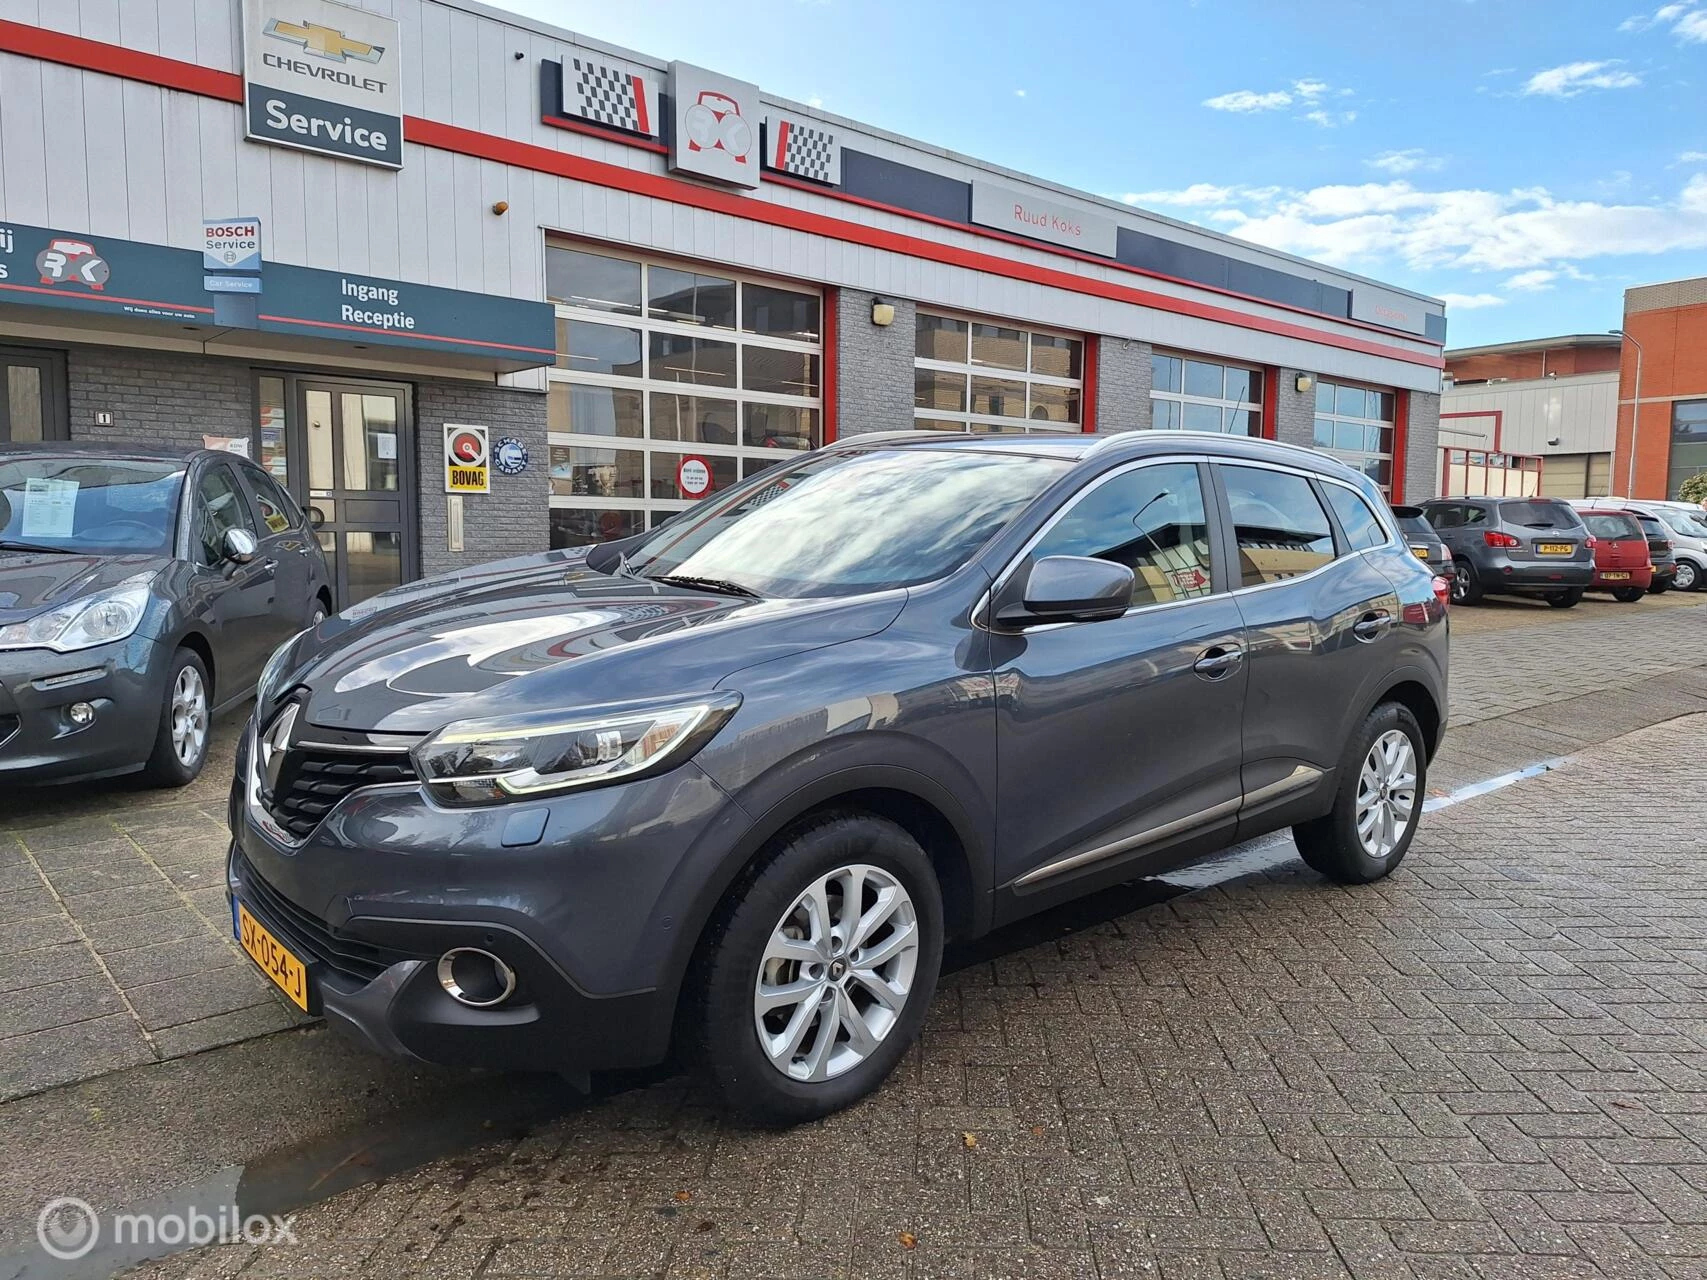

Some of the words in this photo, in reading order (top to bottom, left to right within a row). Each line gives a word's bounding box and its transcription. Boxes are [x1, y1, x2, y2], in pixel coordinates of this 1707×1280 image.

[263, 53, 387, 93] CHEVROLET
[266, 99, 387, 150] Service
[1014, 204, 1047, 226] Ruud
[1052, 215, 1081, 236] Koks
[206, 226, 255, 237] BOSCH
[206, 239, 255, 249] Service
[225, 281, 253, 289] Service
[342, 279, 398, 305] Ingang
[342, 304, 415, 329] Receptie
[103, 414, 107, 423] 1
[494, 438, 528, 455] SCHADE
[494, 458, 526, 474] GARANT
[452, 470, 484, 486] BOVAG
[243, 913, 301, 998] SX-054-J
